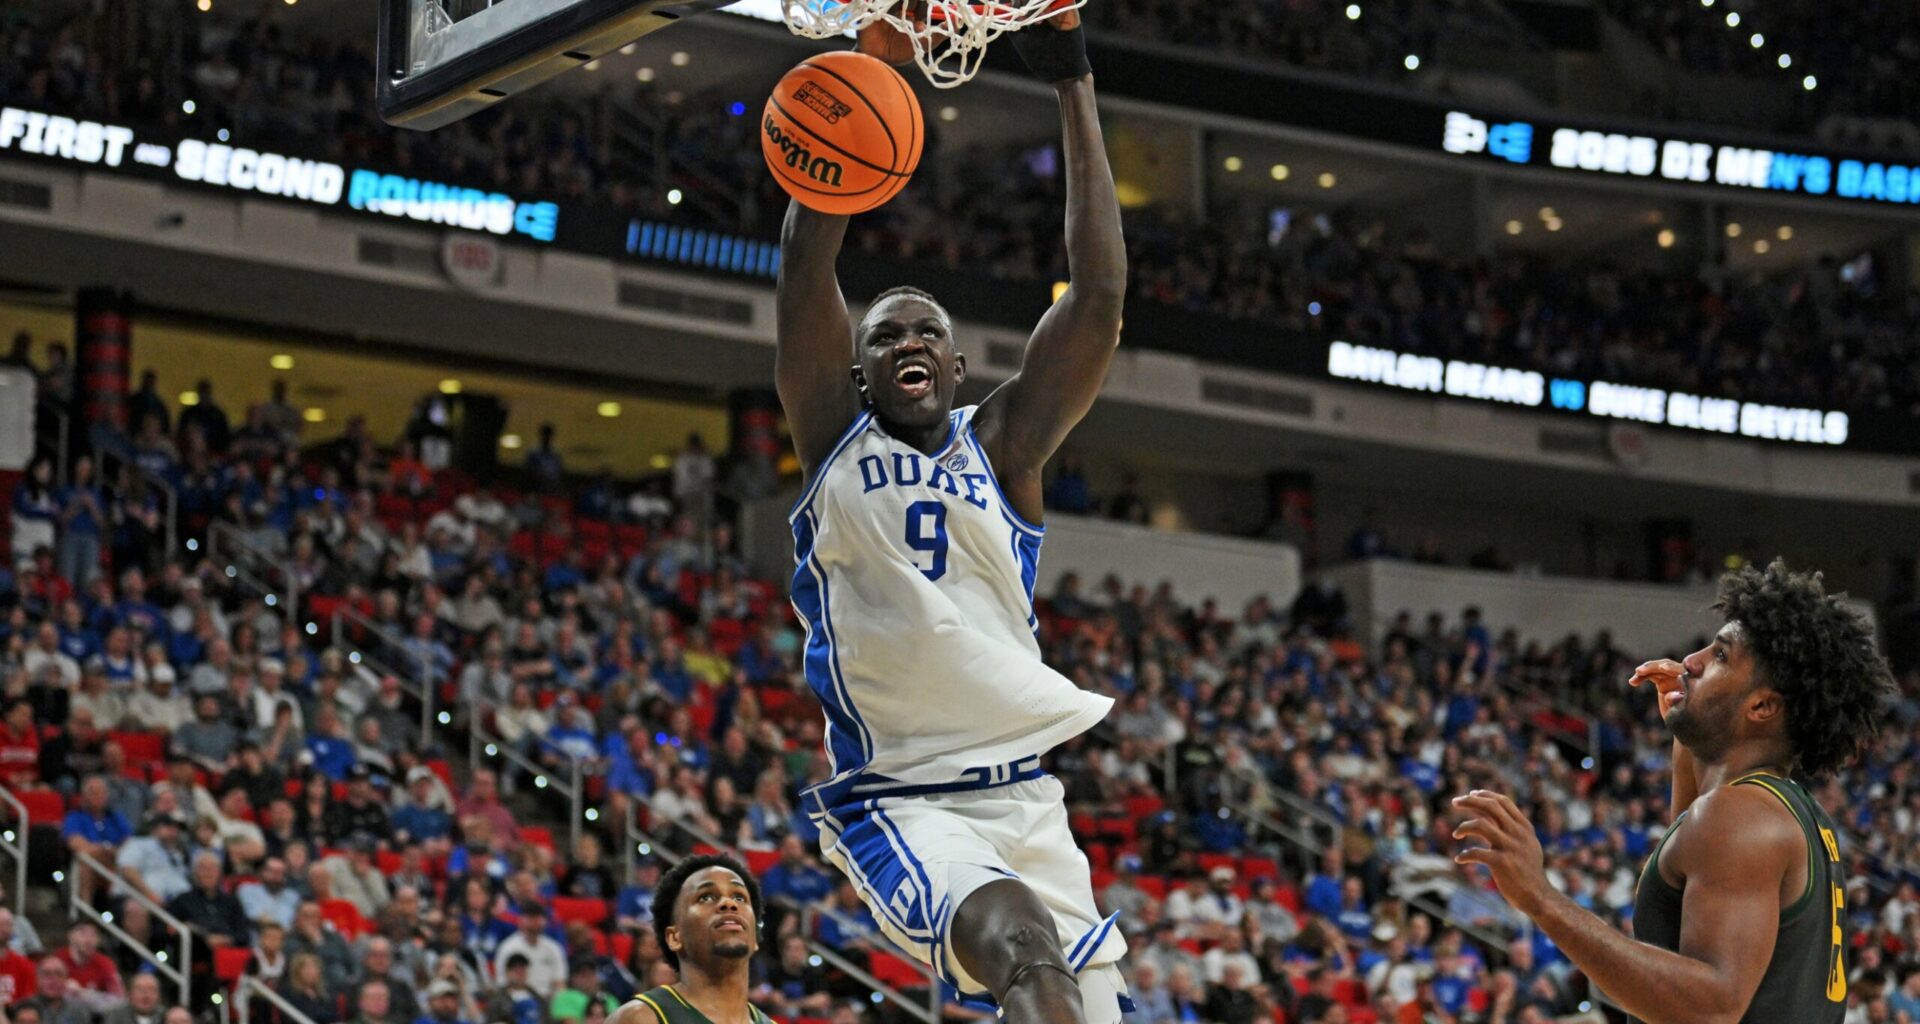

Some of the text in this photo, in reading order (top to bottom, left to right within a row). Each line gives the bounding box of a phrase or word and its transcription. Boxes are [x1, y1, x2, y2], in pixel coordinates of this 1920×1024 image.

[0, 107, 134, 167] FIRST
[174, 138, 345, 204] SECOND
[348, 169, 517, 235] ROUNDS
[764, 113, 843, 187] Wilson
[1550, 128, 1658, 176] 2025
[1715, 146, 1832, 194] MEN'S
[1328, 341, 1849, 445] BAYLOR BEARS VS DUKE BLUE DEVILS
[905, 500, 949, 582] 9
